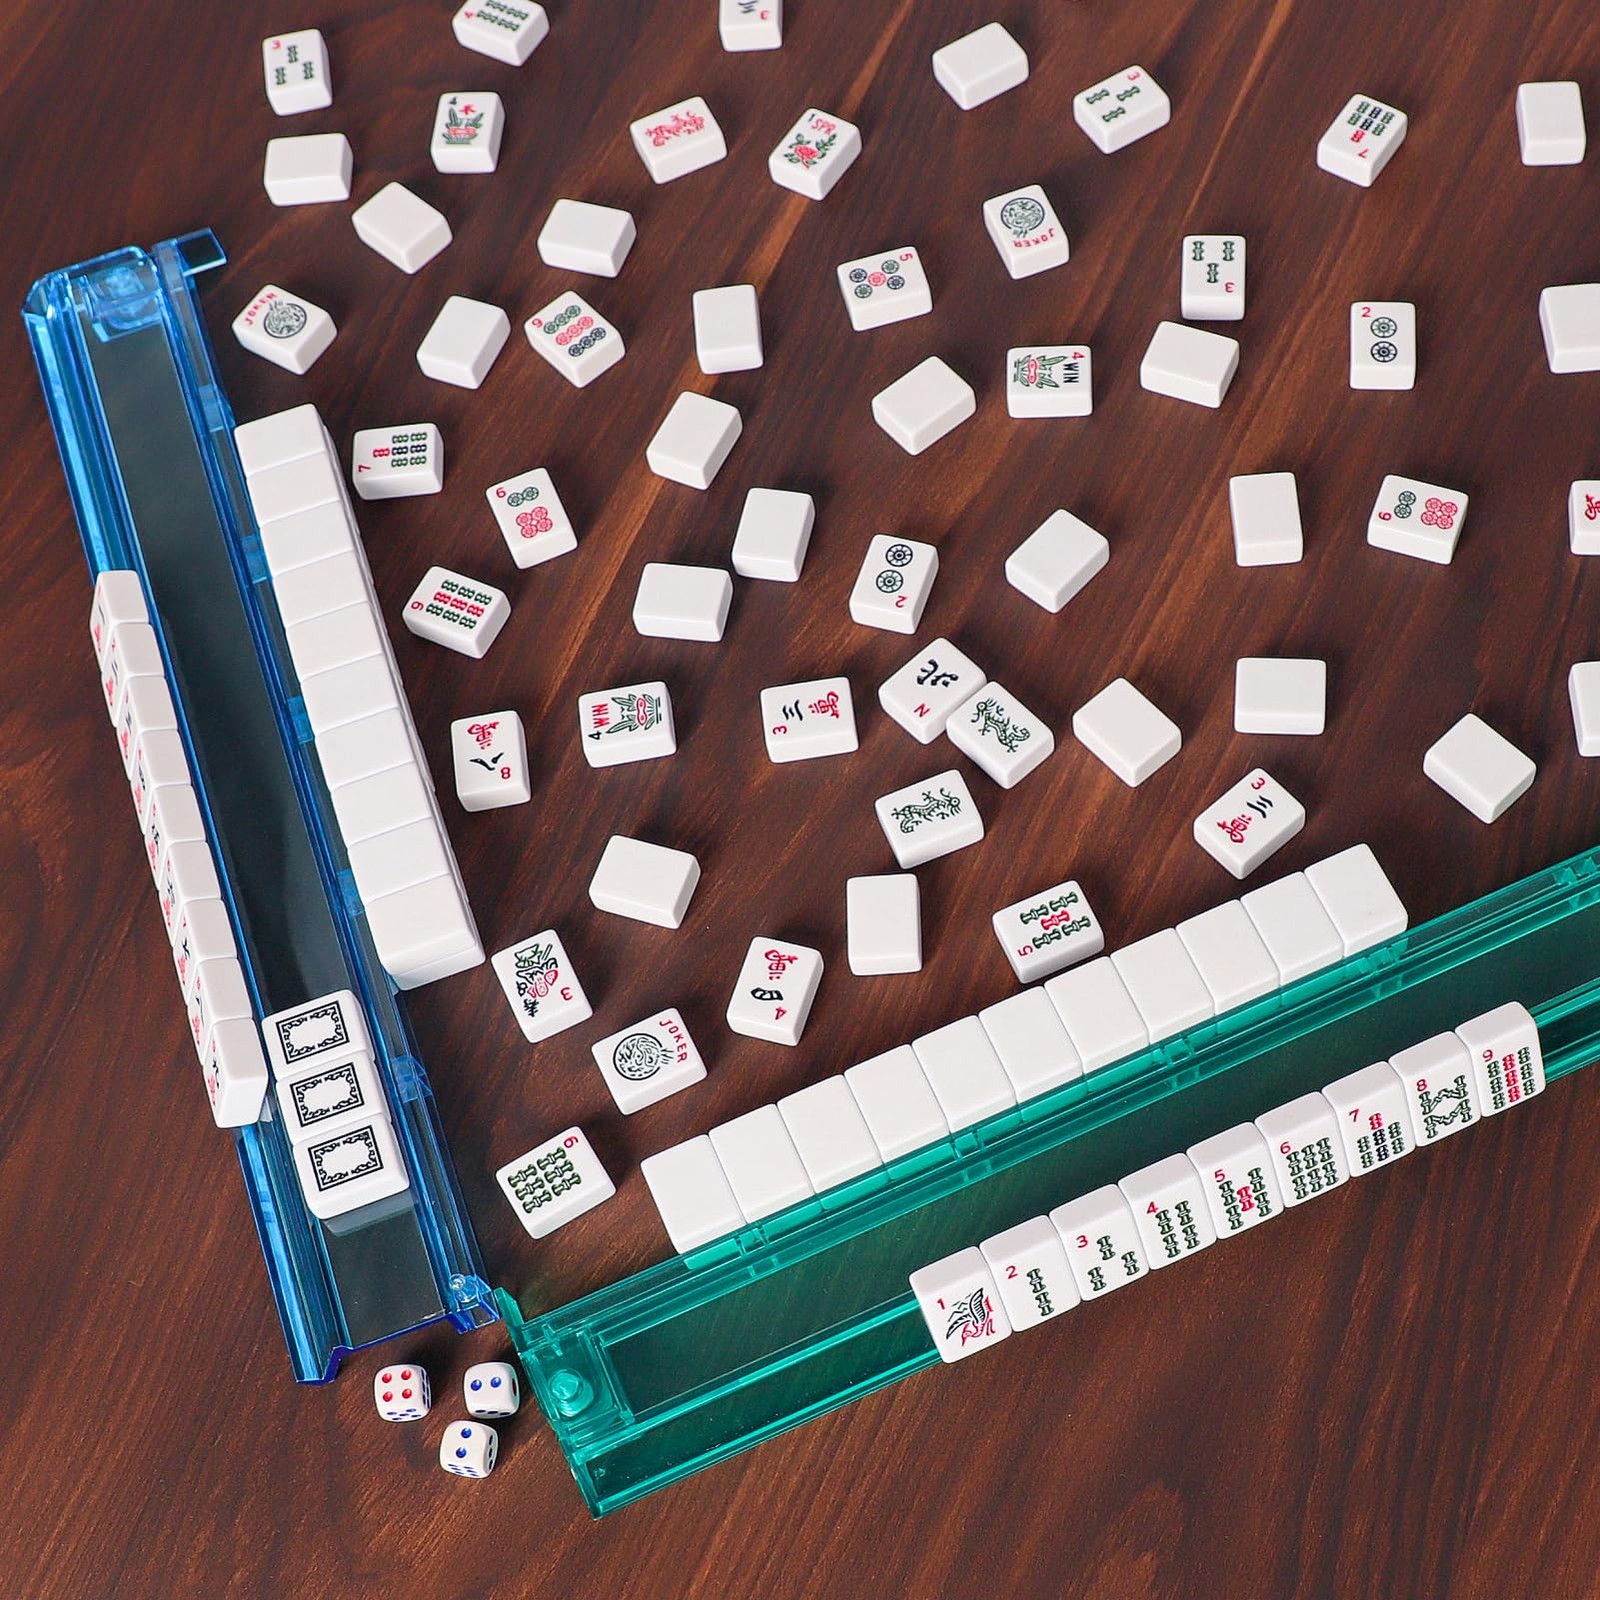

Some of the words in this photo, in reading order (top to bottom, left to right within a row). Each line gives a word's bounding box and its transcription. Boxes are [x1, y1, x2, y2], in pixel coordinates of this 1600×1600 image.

[1125, 70, 1141, 82] 3
[1357, 148, 1369, 159] 7
[1012, 227, 1054, 248] JOKER
[898, 252, 913, 264] 5
[1224, 281, 1235, 294] 3
[242, 290, 277, 327] JOKER
[1361, 306, 1372, 318] 2
[530, 315, 544, 329] 9
[1071, 351, 1086, 361] 4
[1063, 363, 1079, 383] WIN
[357, 464, 372, 473] 7
[493, 484, 507, 499] 6
[1377, 511, 1393, 522] 6
[409, 599, 425, 612] 9
[894, 594, 908, 609] 2
[592, 704, 609, 728] WIN
[913, 703, 931, 718] N
[587, 730, 603, 741] 4
[772, 725, 788, 735] 3
[500, 766, 512, 780] 8
[1250, 777, 1266, 791] 3
[1017, 941, 1036, 957] 5
[560, 986, 574, 1002] 3
[774, 1006, 788, 1021] 4
[659, 1018, 690, 1064] JOKER
[1482, 1049, 1497, 1065] 9
[1416, 1078, 1430, 1094] 8
[1348, 1108, 1360, 1123] 7
[563, 1135, 579, 1149] 6
[1279, 1141, 1292, 1158] 6
[1214, 1168, 1228, 1184] 5
[1146, 1201, 1161, 1217] 4
[1075, 1234, 1089, 1249] 3
[1005, 1265, 1019, 1280] 2
[936, 1297, 946, 1311] 1
